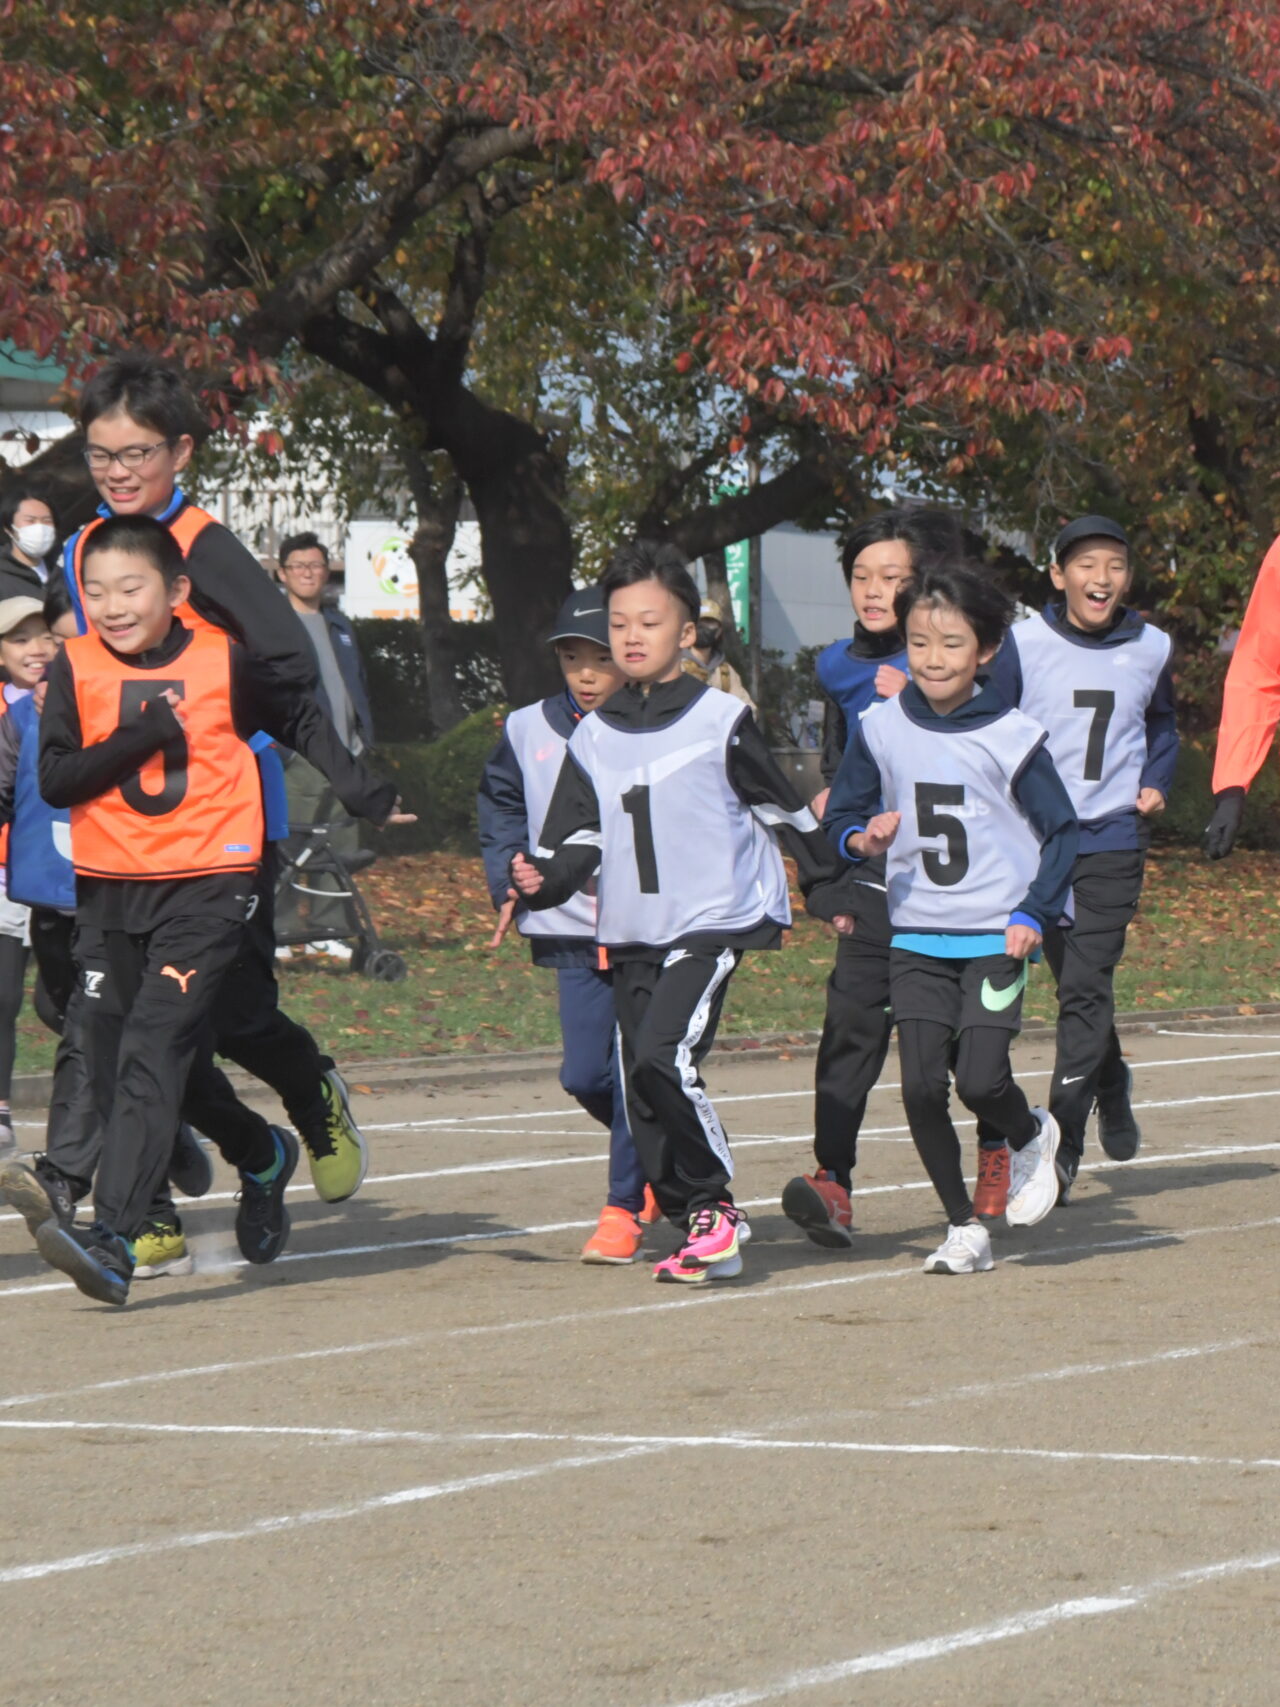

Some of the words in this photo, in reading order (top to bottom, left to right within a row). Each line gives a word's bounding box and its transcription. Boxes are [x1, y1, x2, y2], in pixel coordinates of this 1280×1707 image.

[1073, 690, 1115, 781] 7
[621, 785, 660, 894] 1
[915, 782, 969, 886] 5
